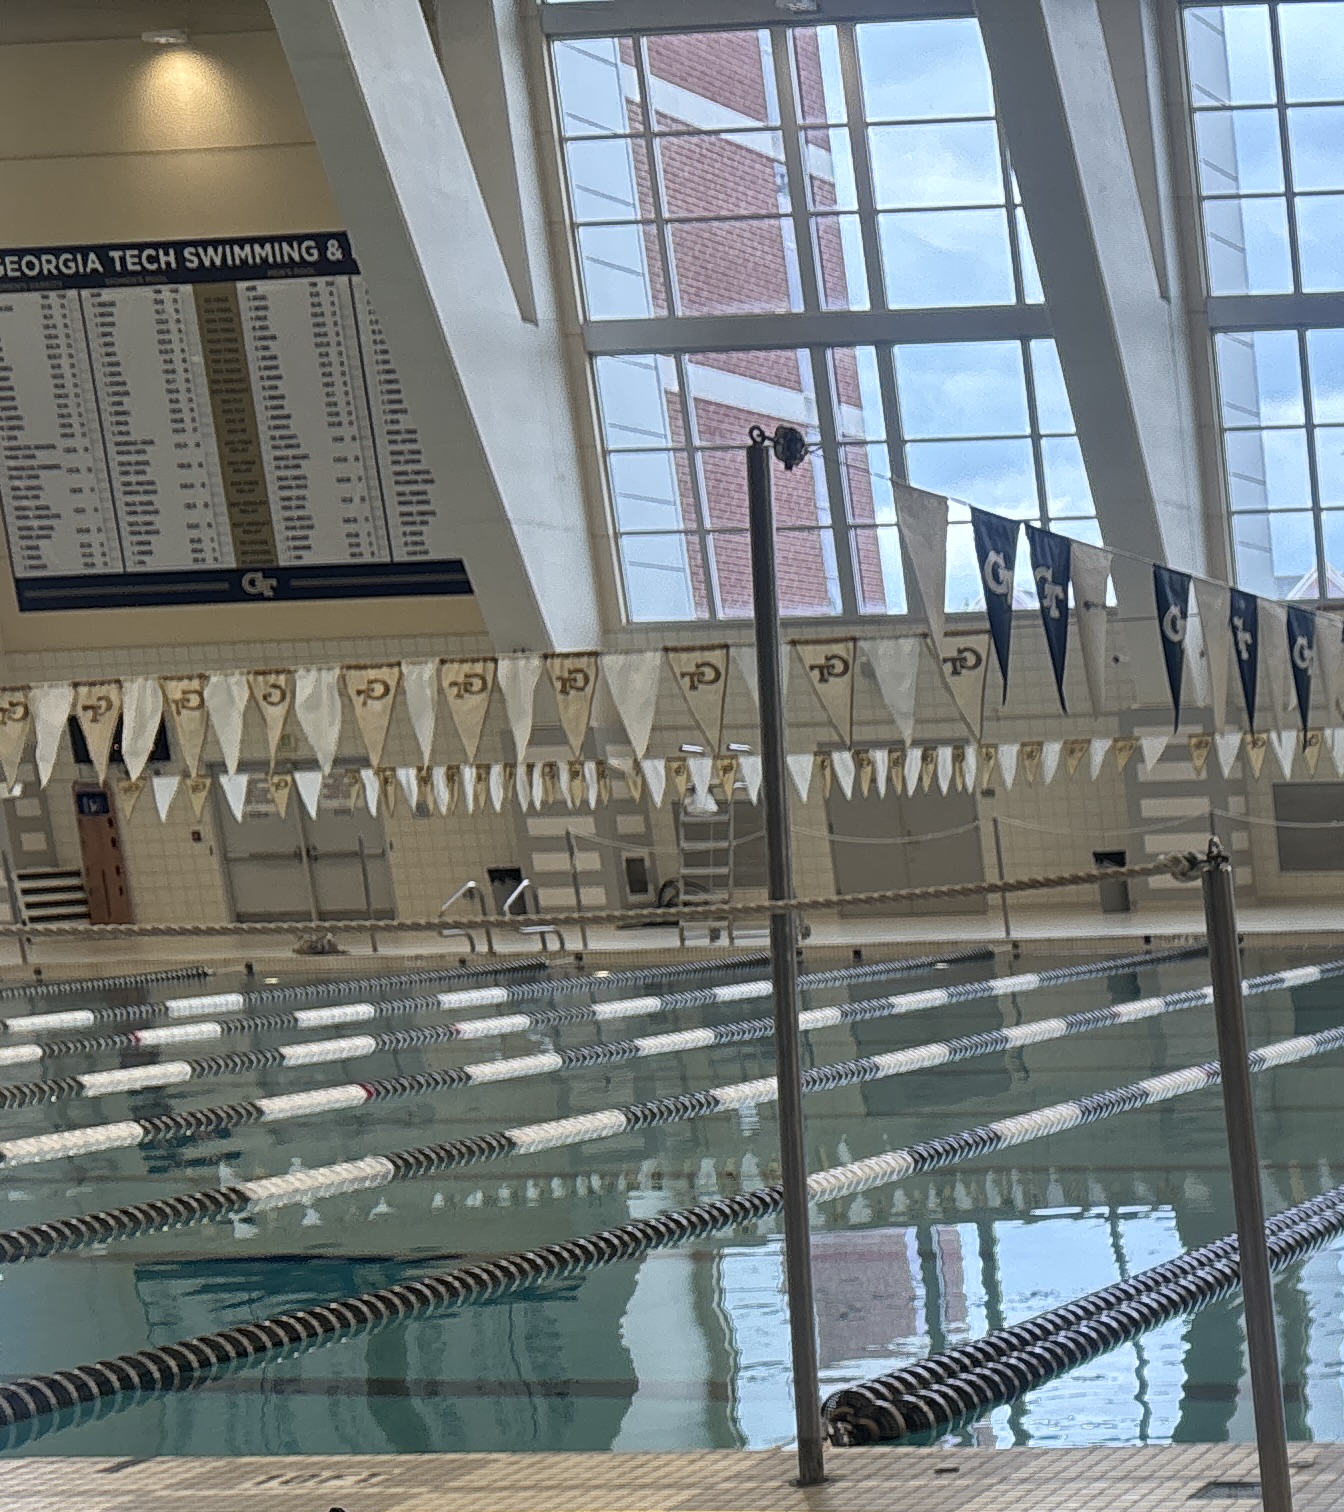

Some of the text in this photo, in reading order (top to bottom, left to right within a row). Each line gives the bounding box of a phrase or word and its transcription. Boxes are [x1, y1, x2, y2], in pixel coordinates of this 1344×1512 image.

[109, 247, 177, 273] TECH
[183, 240, 320, 269] SWIMMING
[326, 239, 344, 261] &
